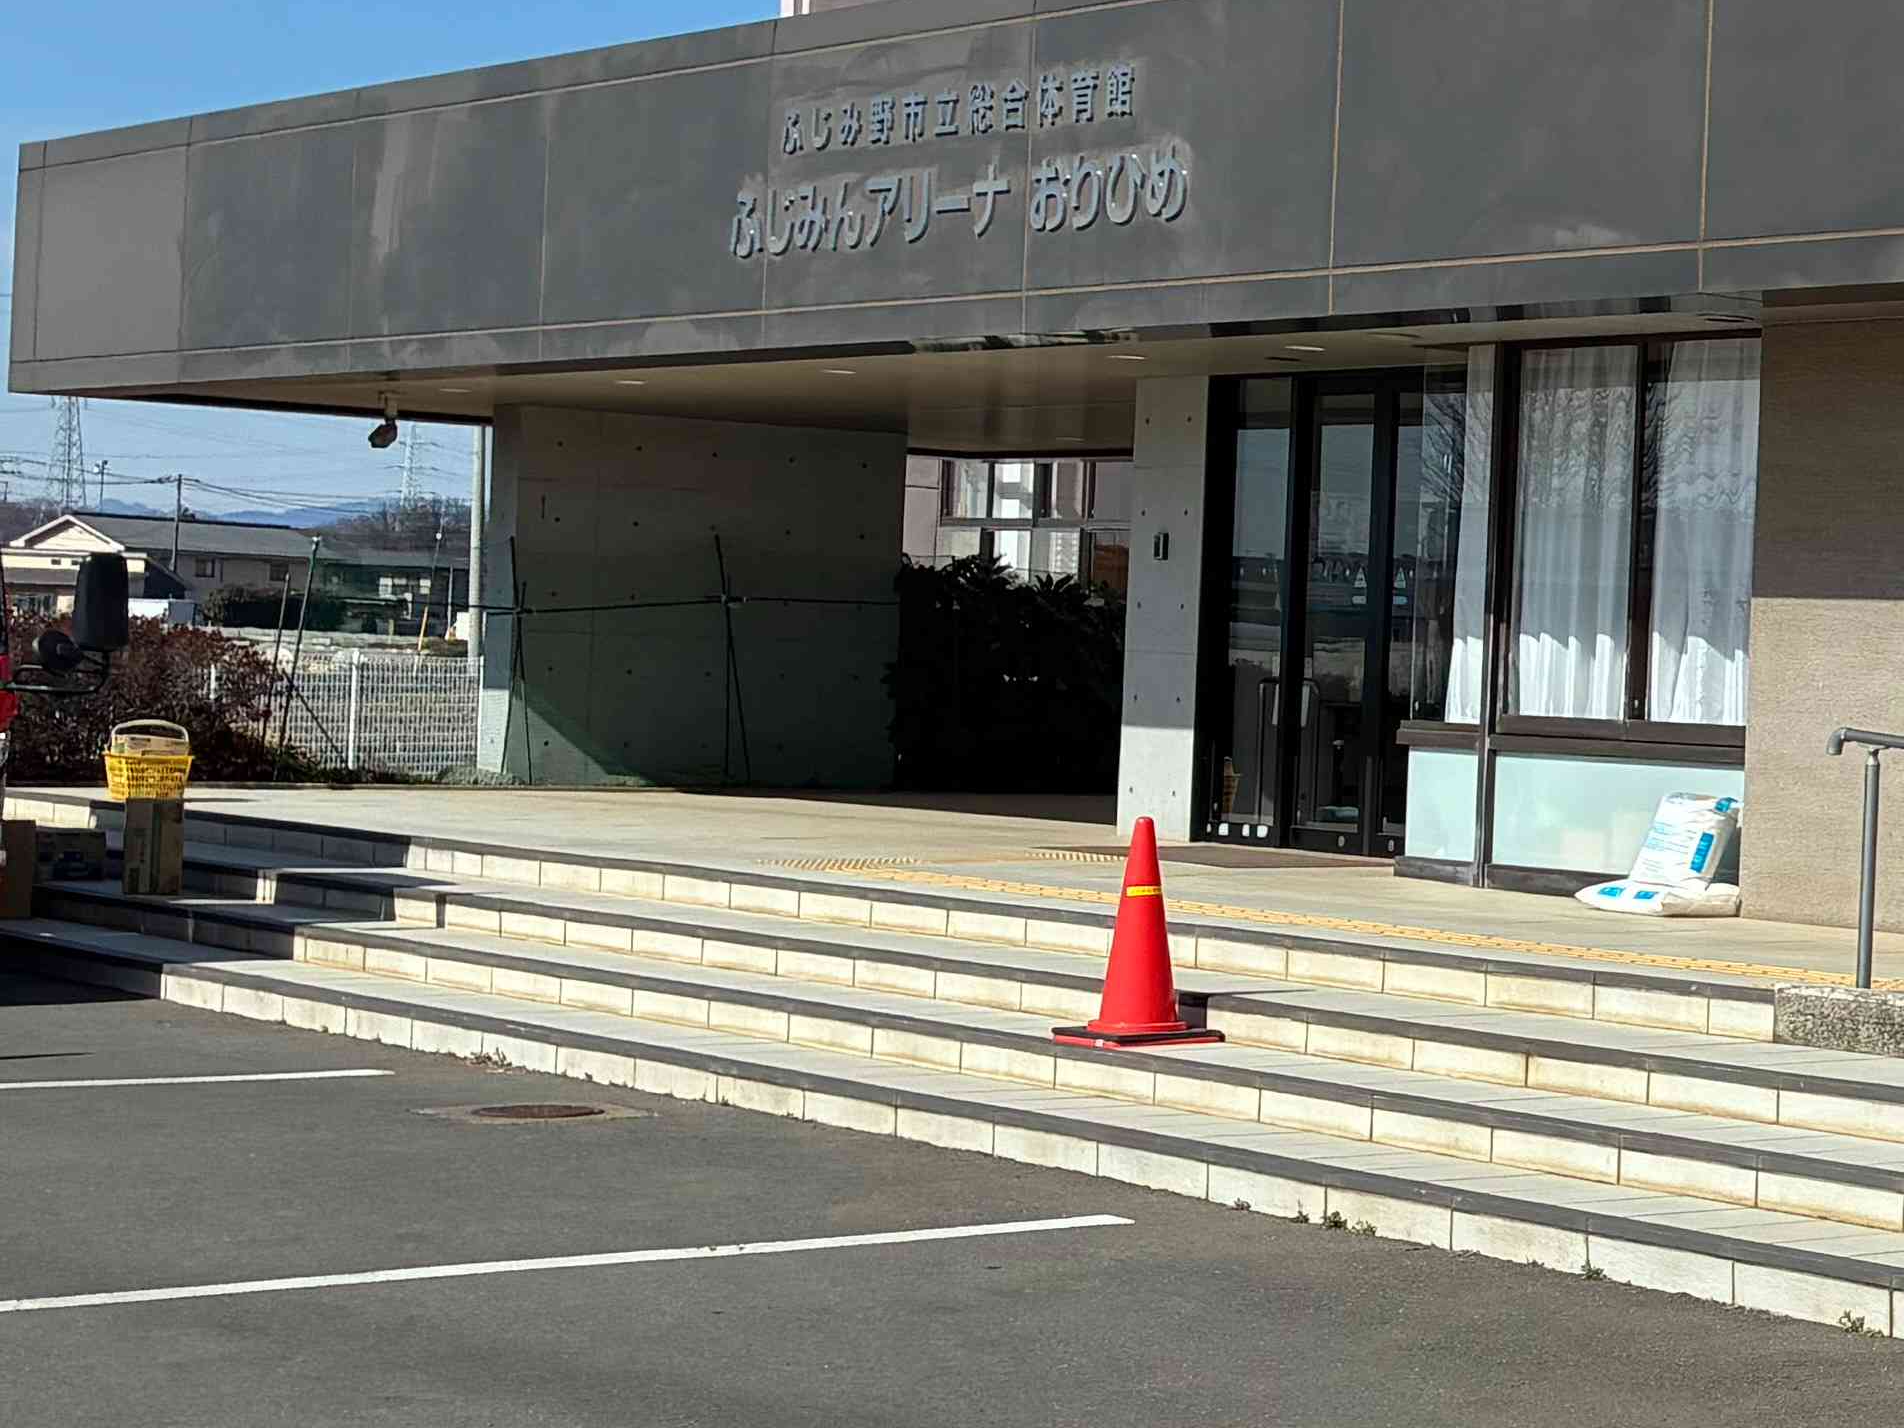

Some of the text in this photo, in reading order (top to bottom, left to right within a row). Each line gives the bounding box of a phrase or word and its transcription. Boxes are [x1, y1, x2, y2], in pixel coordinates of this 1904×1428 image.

[782, 62, 1136, 156] ふじみ野市立総合体育館
[731, 142, 1191, 260] ふじみんアリーナ おりひめ
